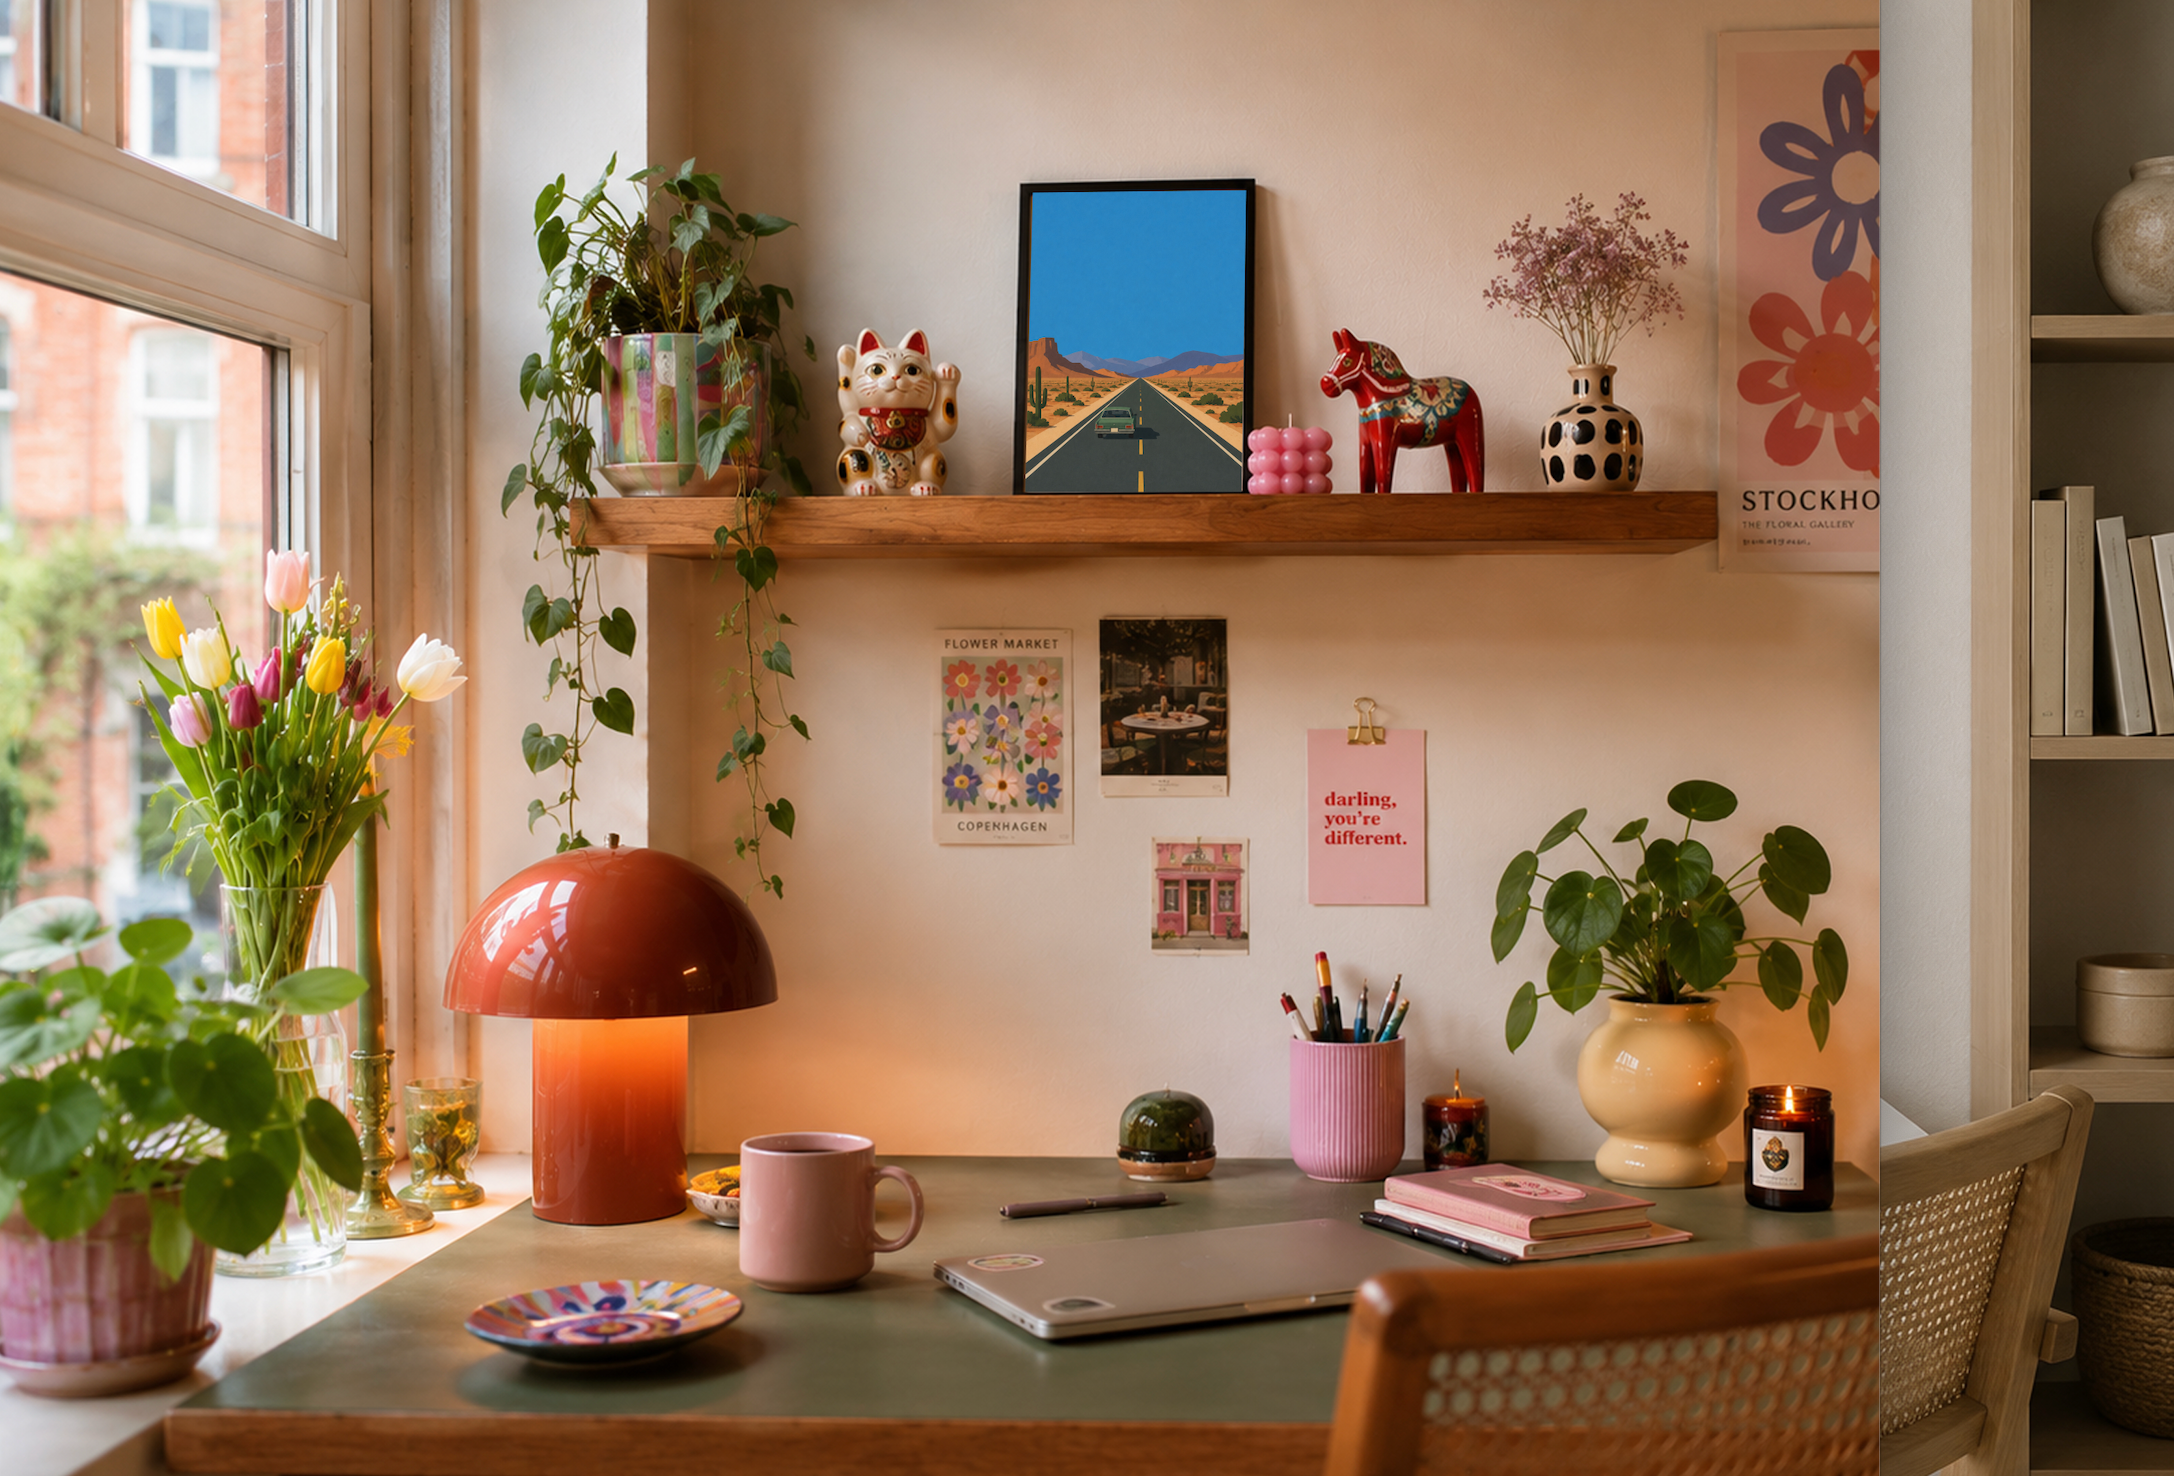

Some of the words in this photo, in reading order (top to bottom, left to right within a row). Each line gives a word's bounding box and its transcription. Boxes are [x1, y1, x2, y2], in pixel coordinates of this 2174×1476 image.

[1742, 489, 1880, 511] STOCKHO
[1742, 520, 1761, 530] THE
[1766, 520, 1806, 529] FLORAL
[944, 638, 999, 649] FLOWER
[1004, 638, 1059, 649] MARKET
[1324, 791, 1397, 810] darling,
[957, 821, 1047, 832] COPENHAGEN
[1324, 811, 1381, 829] you’re
[1324, 830, 1408, 846] different.
